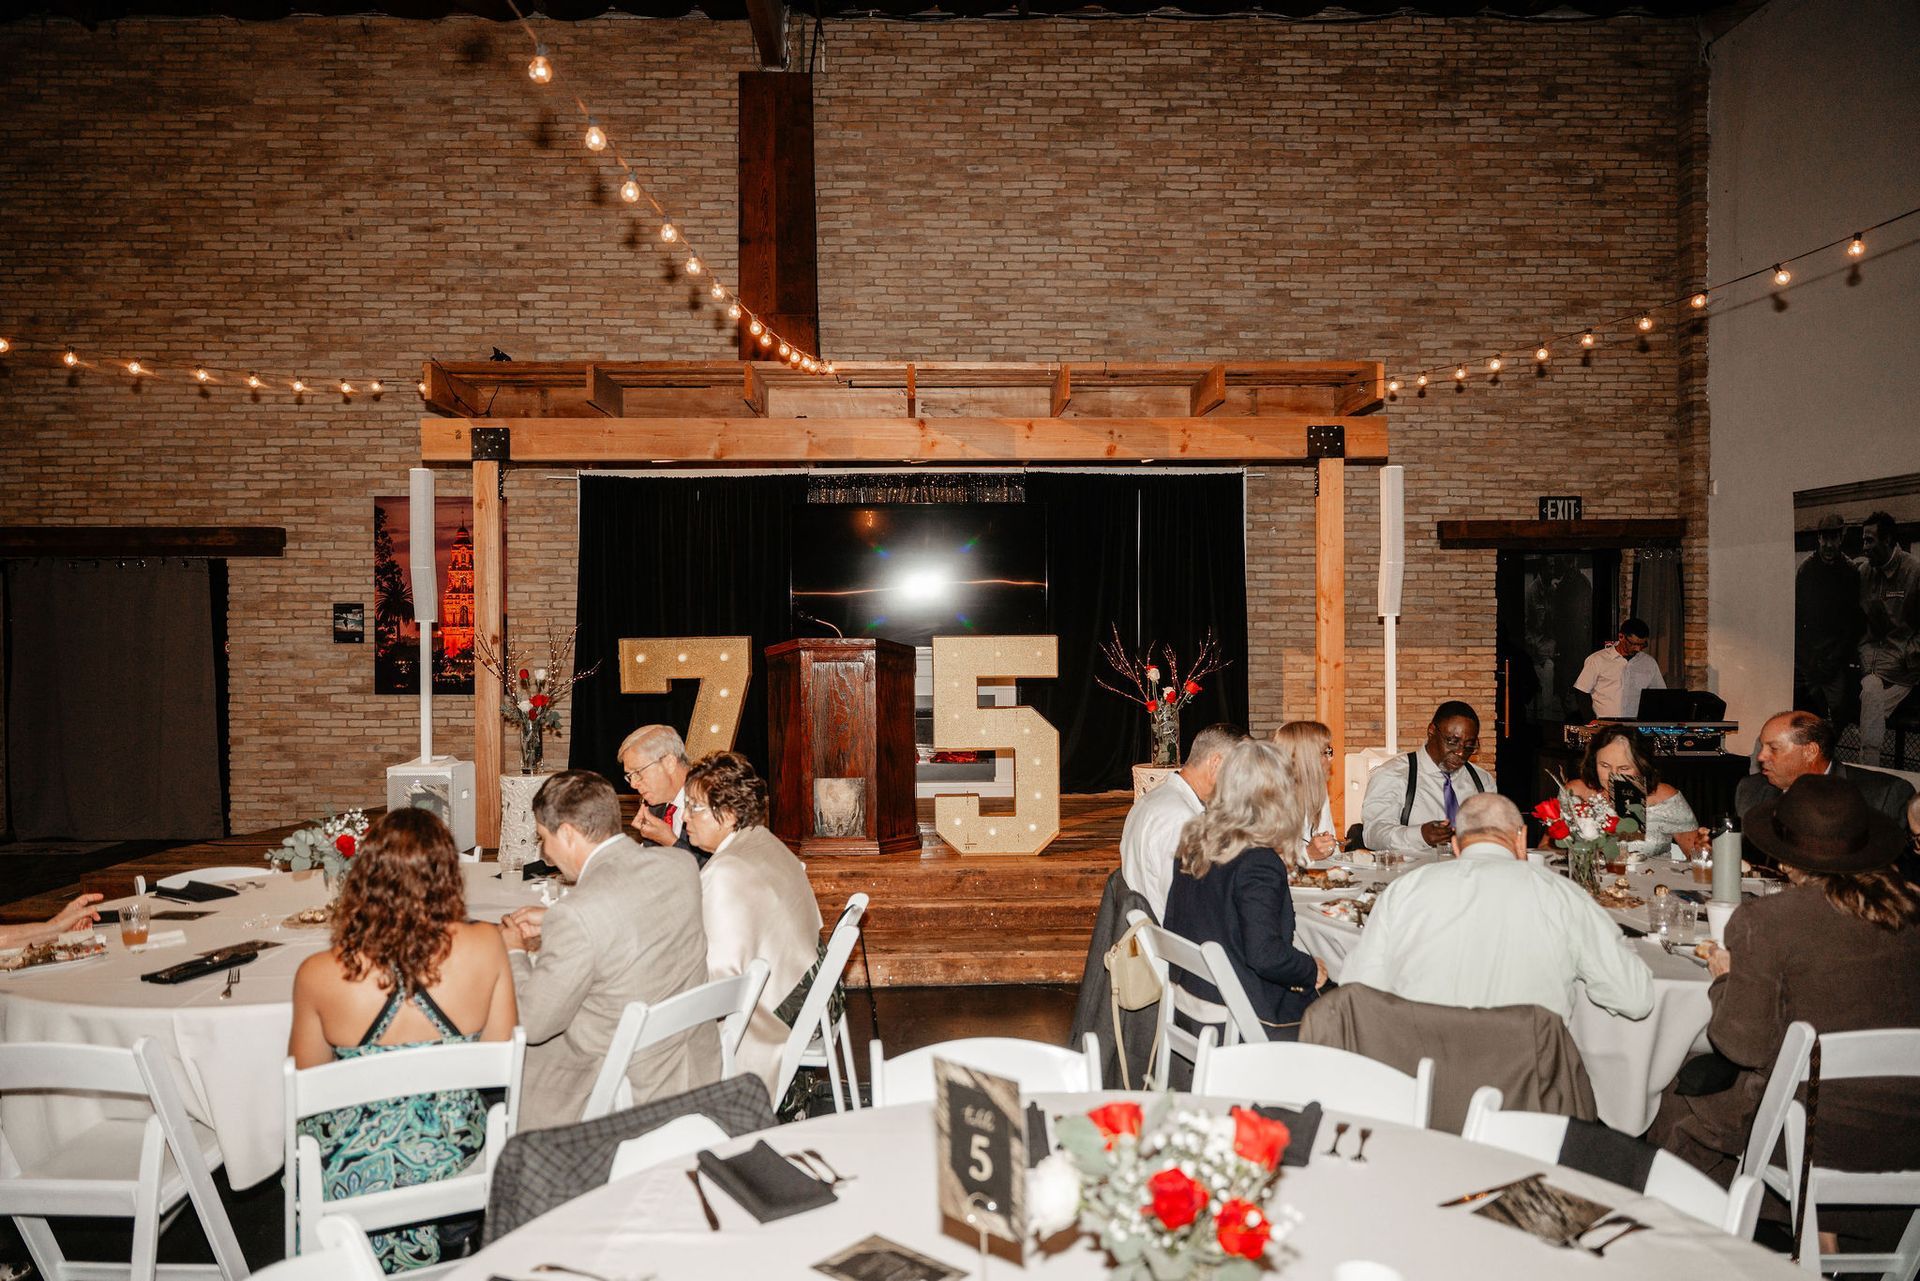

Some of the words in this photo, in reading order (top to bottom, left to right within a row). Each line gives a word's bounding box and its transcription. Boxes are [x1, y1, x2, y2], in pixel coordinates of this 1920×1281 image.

[1547, 499, 1577, 521] EXIT
[618, 635, 752, 765] 7
[931, 634, 1060, 857] 5
[968, 1133, 994, 1182] 5
